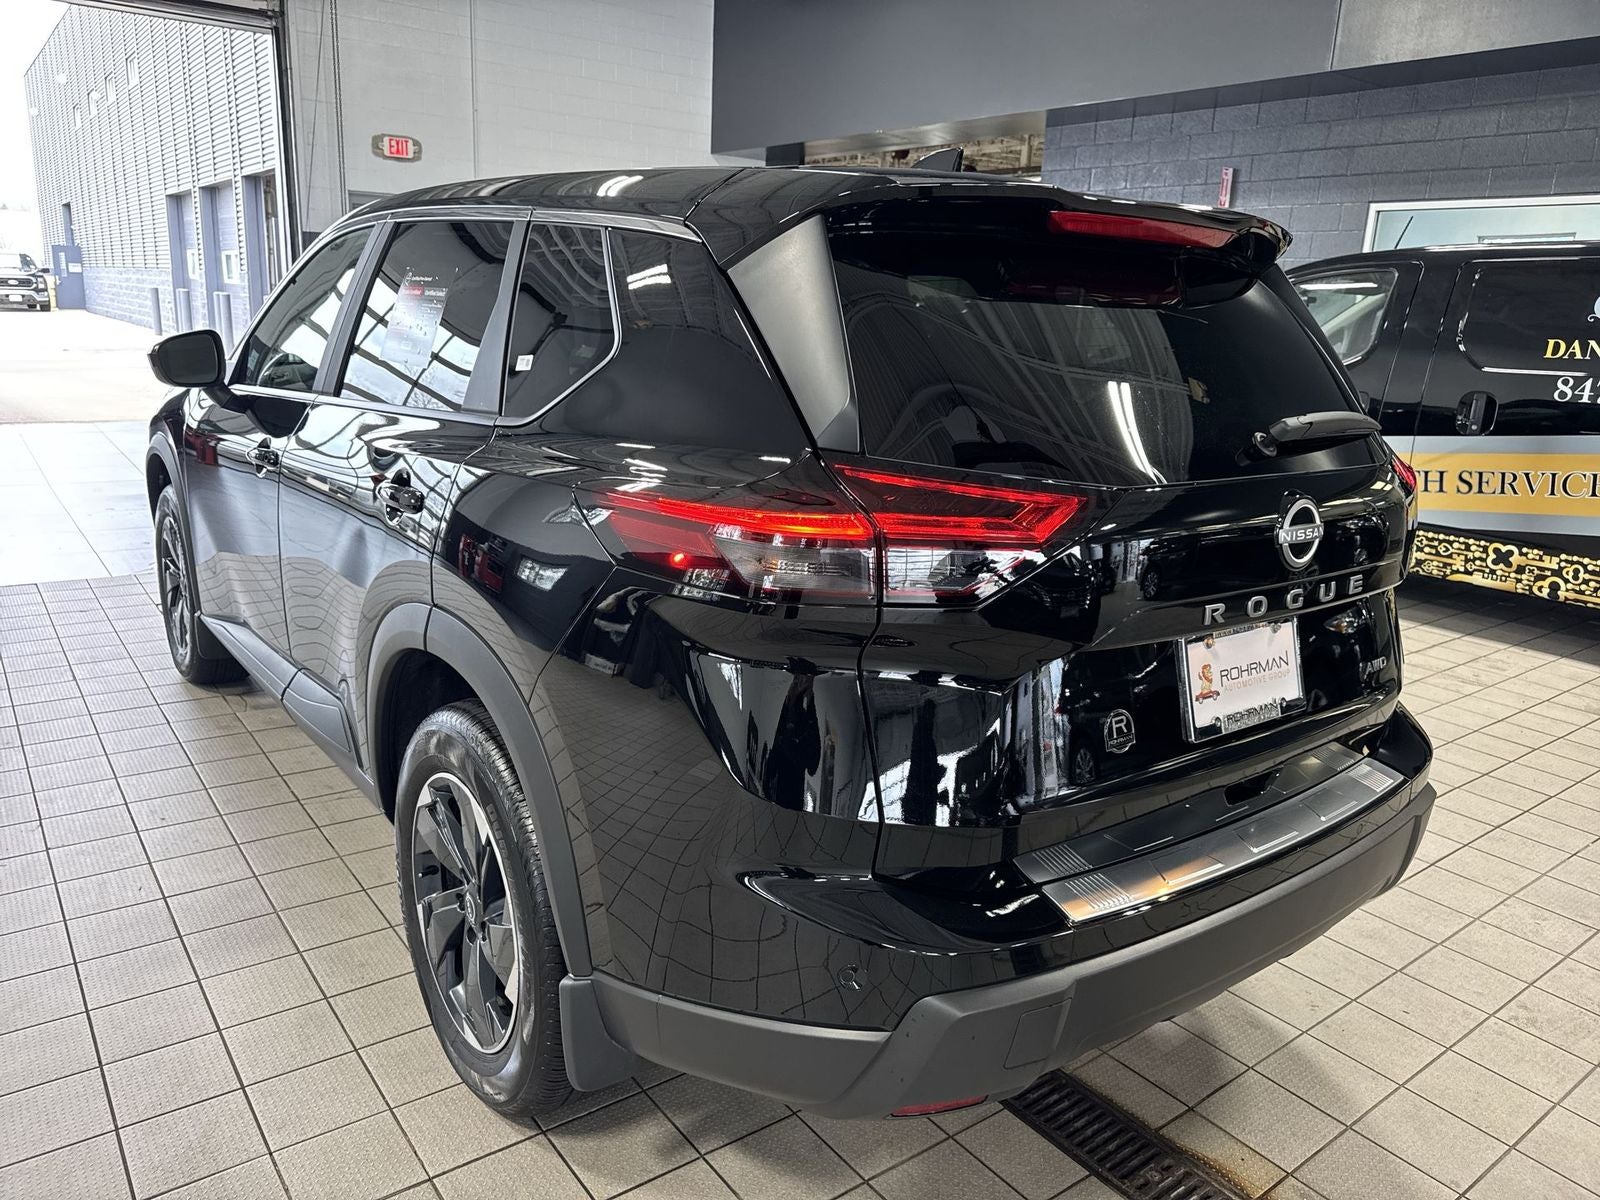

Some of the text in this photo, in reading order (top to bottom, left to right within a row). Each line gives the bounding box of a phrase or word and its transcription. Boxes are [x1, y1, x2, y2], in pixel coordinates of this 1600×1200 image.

[389, 137, 409, 156] EXIT
[1281, 526, 1324, 542] NISSAN
[1203, 574, 1364, 626] ROGUE
[1219, 650, 1289, 688] ROHRMAN
[1224, 668, 1291, 693] AUTOMOTIVE GROUP
[1226, 698, 1279, 727] ROHRMAN
[1112, 715, 1128, 739] R
